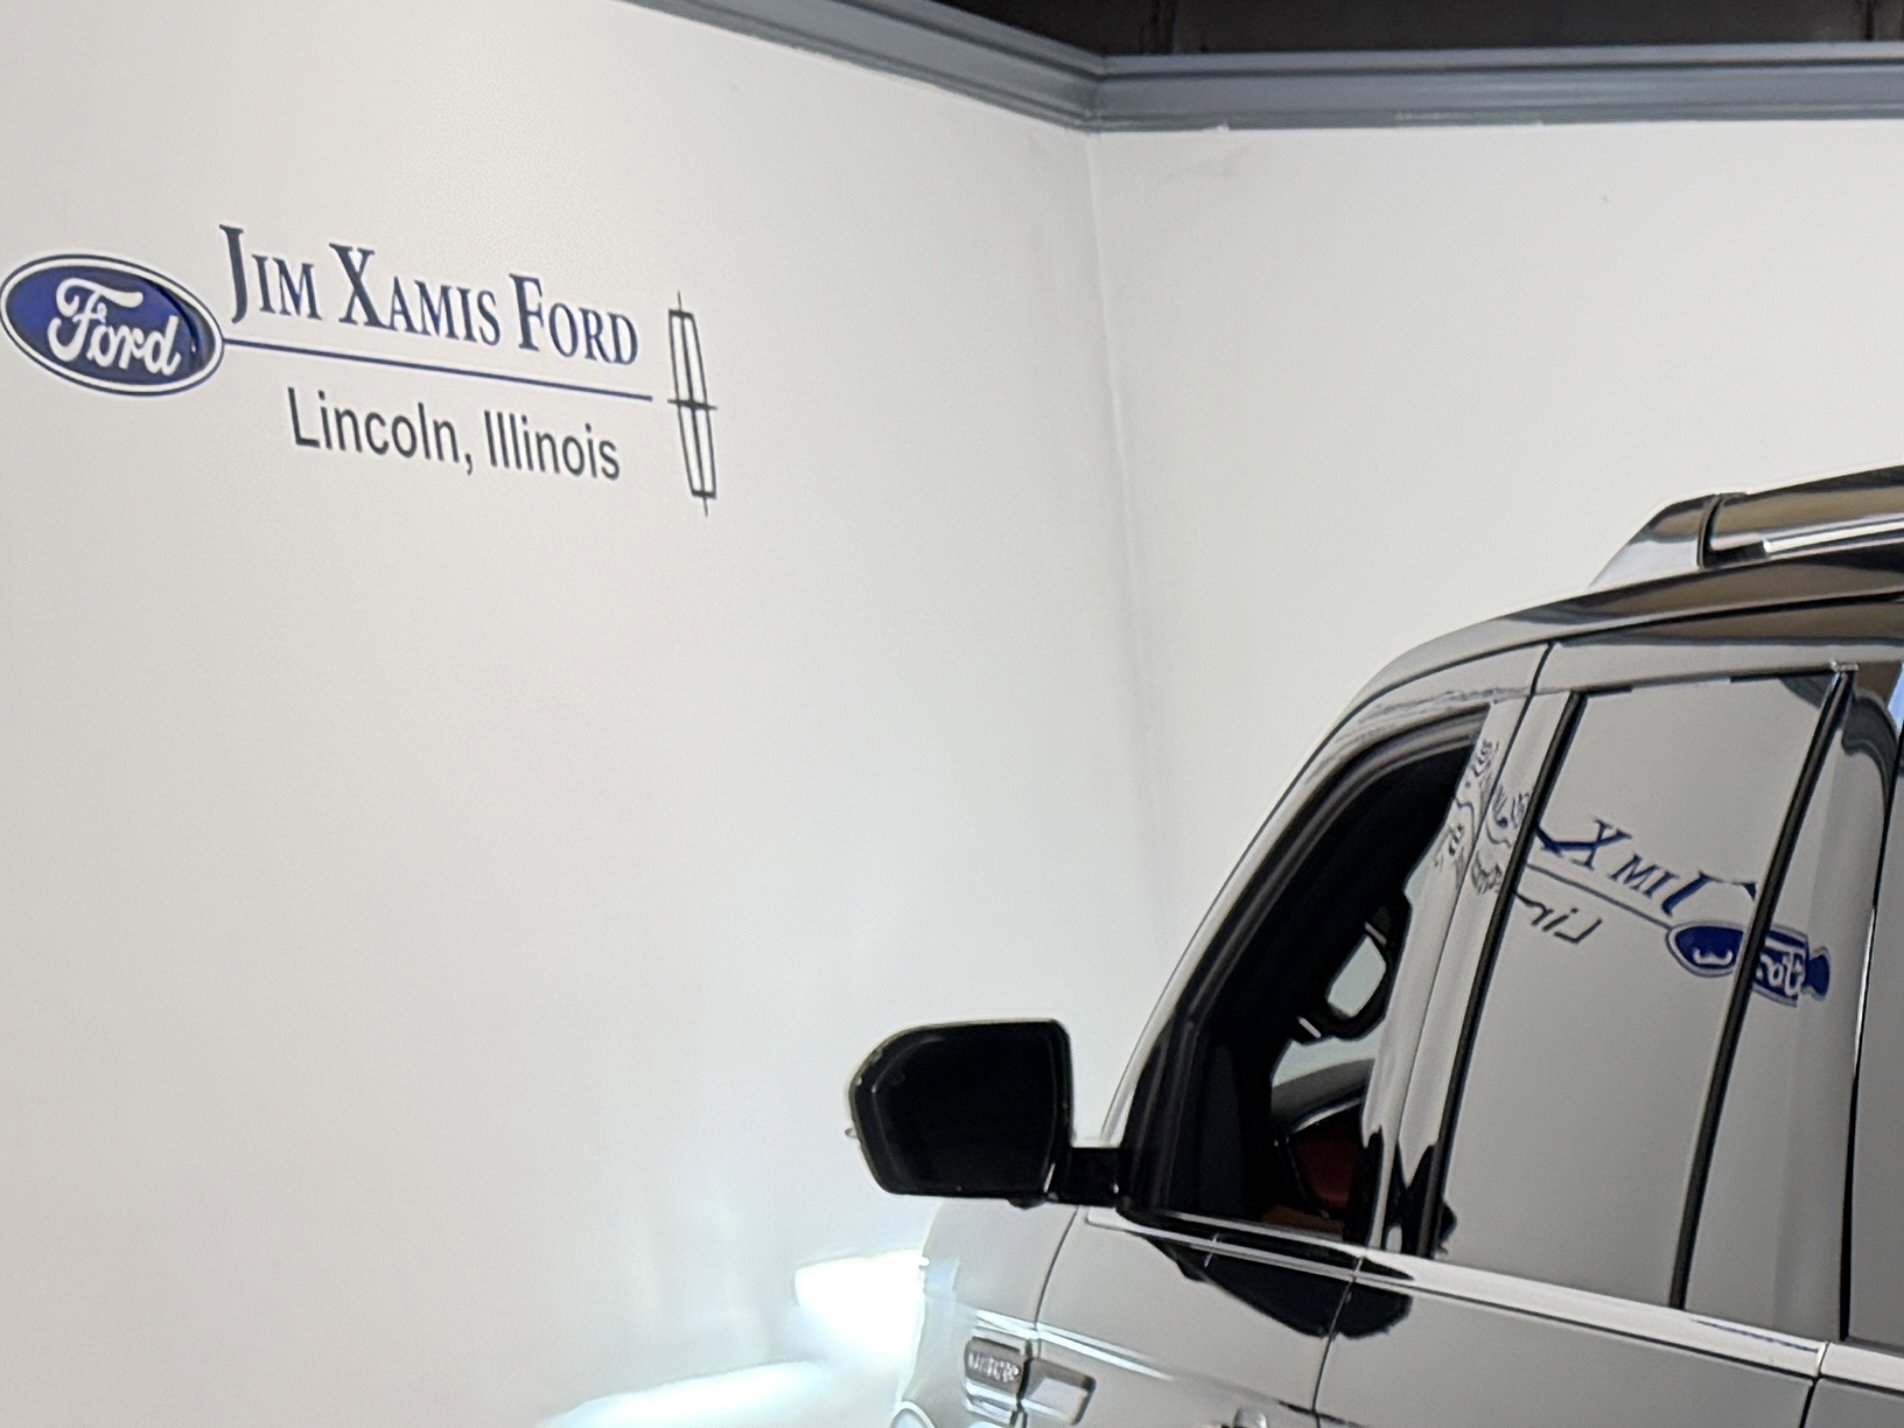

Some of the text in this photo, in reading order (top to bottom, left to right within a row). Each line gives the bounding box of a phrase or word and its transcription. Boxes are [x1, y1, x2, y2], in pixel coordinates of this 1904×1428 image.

[47, 277, 181, 376] Ford
[219, 223, 640, 366] JIM XAMIS FORD
[287, 386, 621, 481] Lincoln, Illinois
